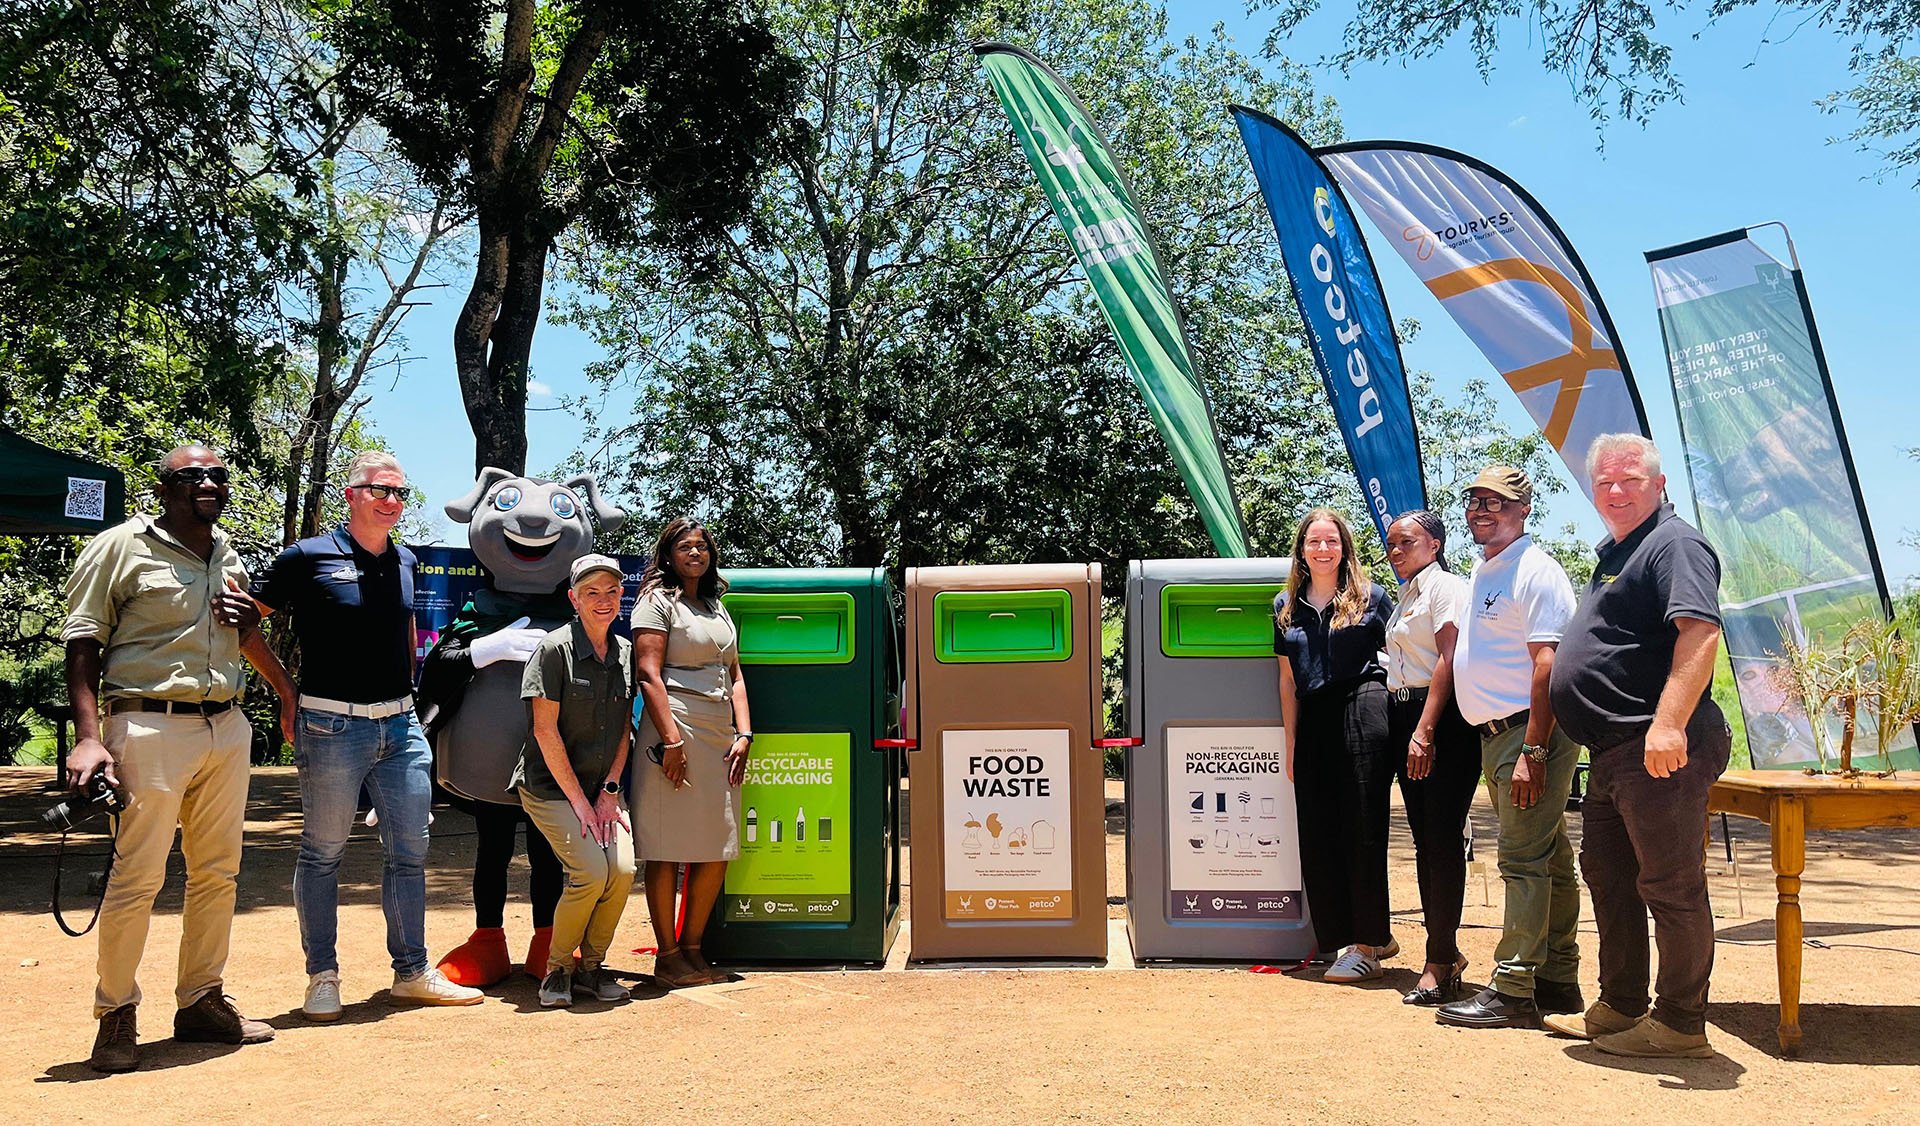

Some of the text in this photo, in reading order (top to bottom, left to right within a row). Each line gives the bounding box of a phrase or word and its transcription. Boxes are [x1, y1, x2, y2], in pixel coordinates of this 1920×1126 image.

[447, 566, 477, 576] and
[1186, 752, 1280, 760] NON-RECYCLABLE
[745, 758, 833, 770] RECYCLABLE
[969, 755, 1044, 775] FOOD
[1186, 762, 1280, 774] PACKAGING
[742, 772, 833, 785] PACKAGING
[962, 778, 1050, 797] WASTE
[808, 902, 834, 912] petco
[1029, 900, 1055, 909] petco
[1257, 900, 1284, 910] petco
